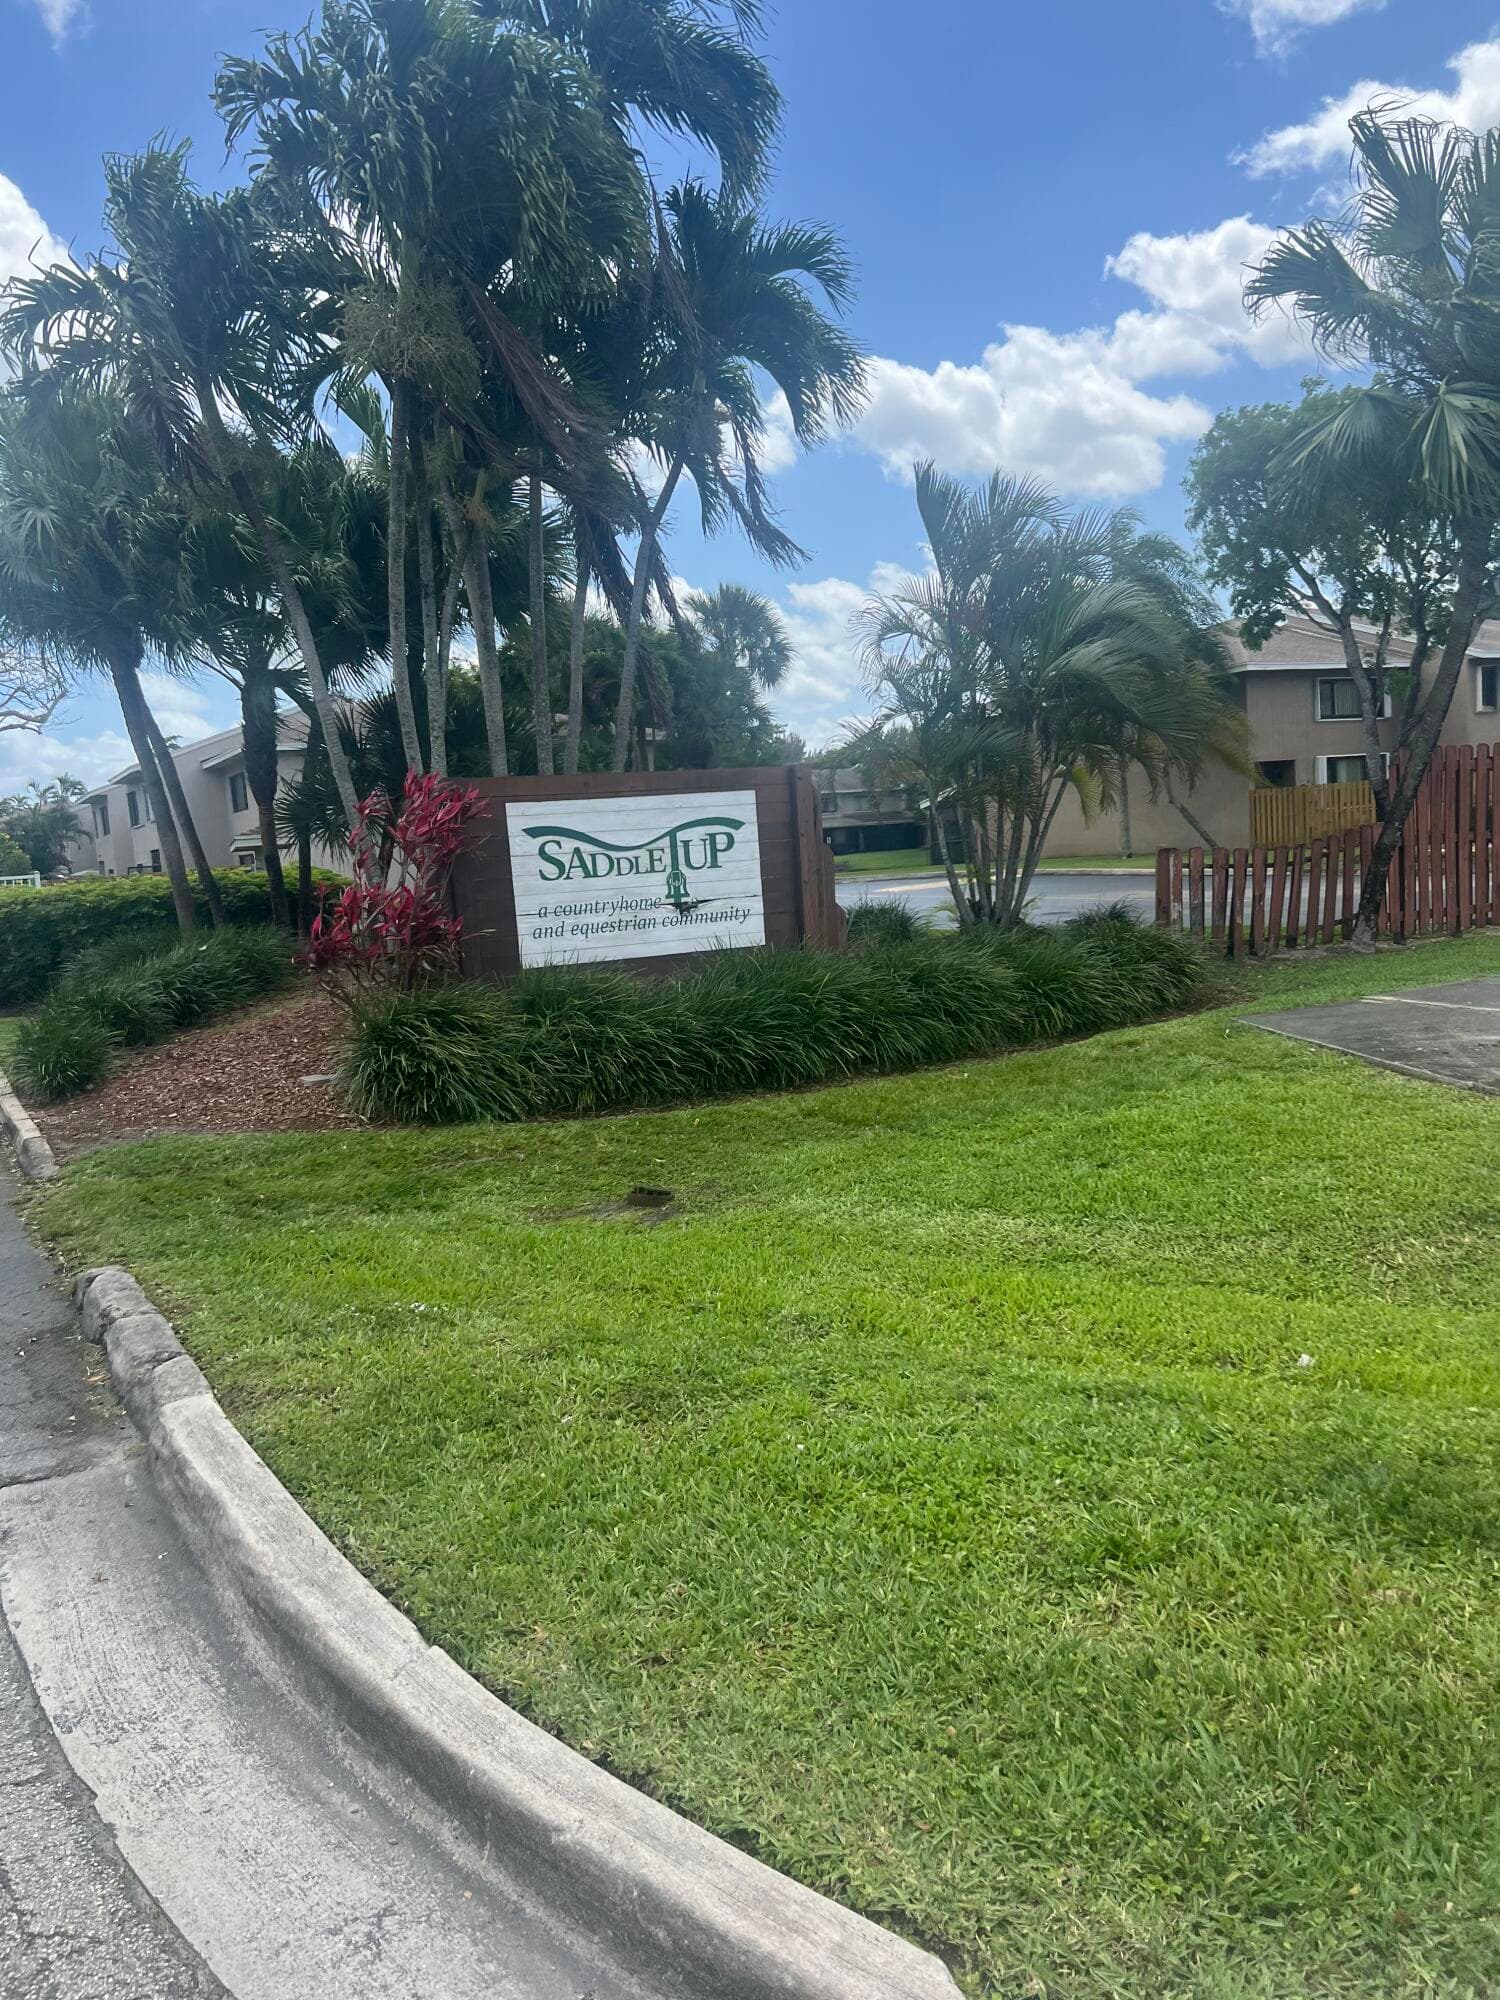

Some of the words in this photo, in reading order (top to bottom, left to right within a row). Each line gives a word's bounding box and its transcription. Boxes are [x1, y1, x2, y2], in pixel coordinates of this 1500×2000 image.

[538, 840, 666, 881] SADDLE
[680, 831, 735, 870] UP
[533, 922, 565, 939] and
[571, 916, 657, 938] equestrian
[662, 906, 750, 928] community
[538, 906, 548, 918] a
[553, 896, 662, 916] countryhome
